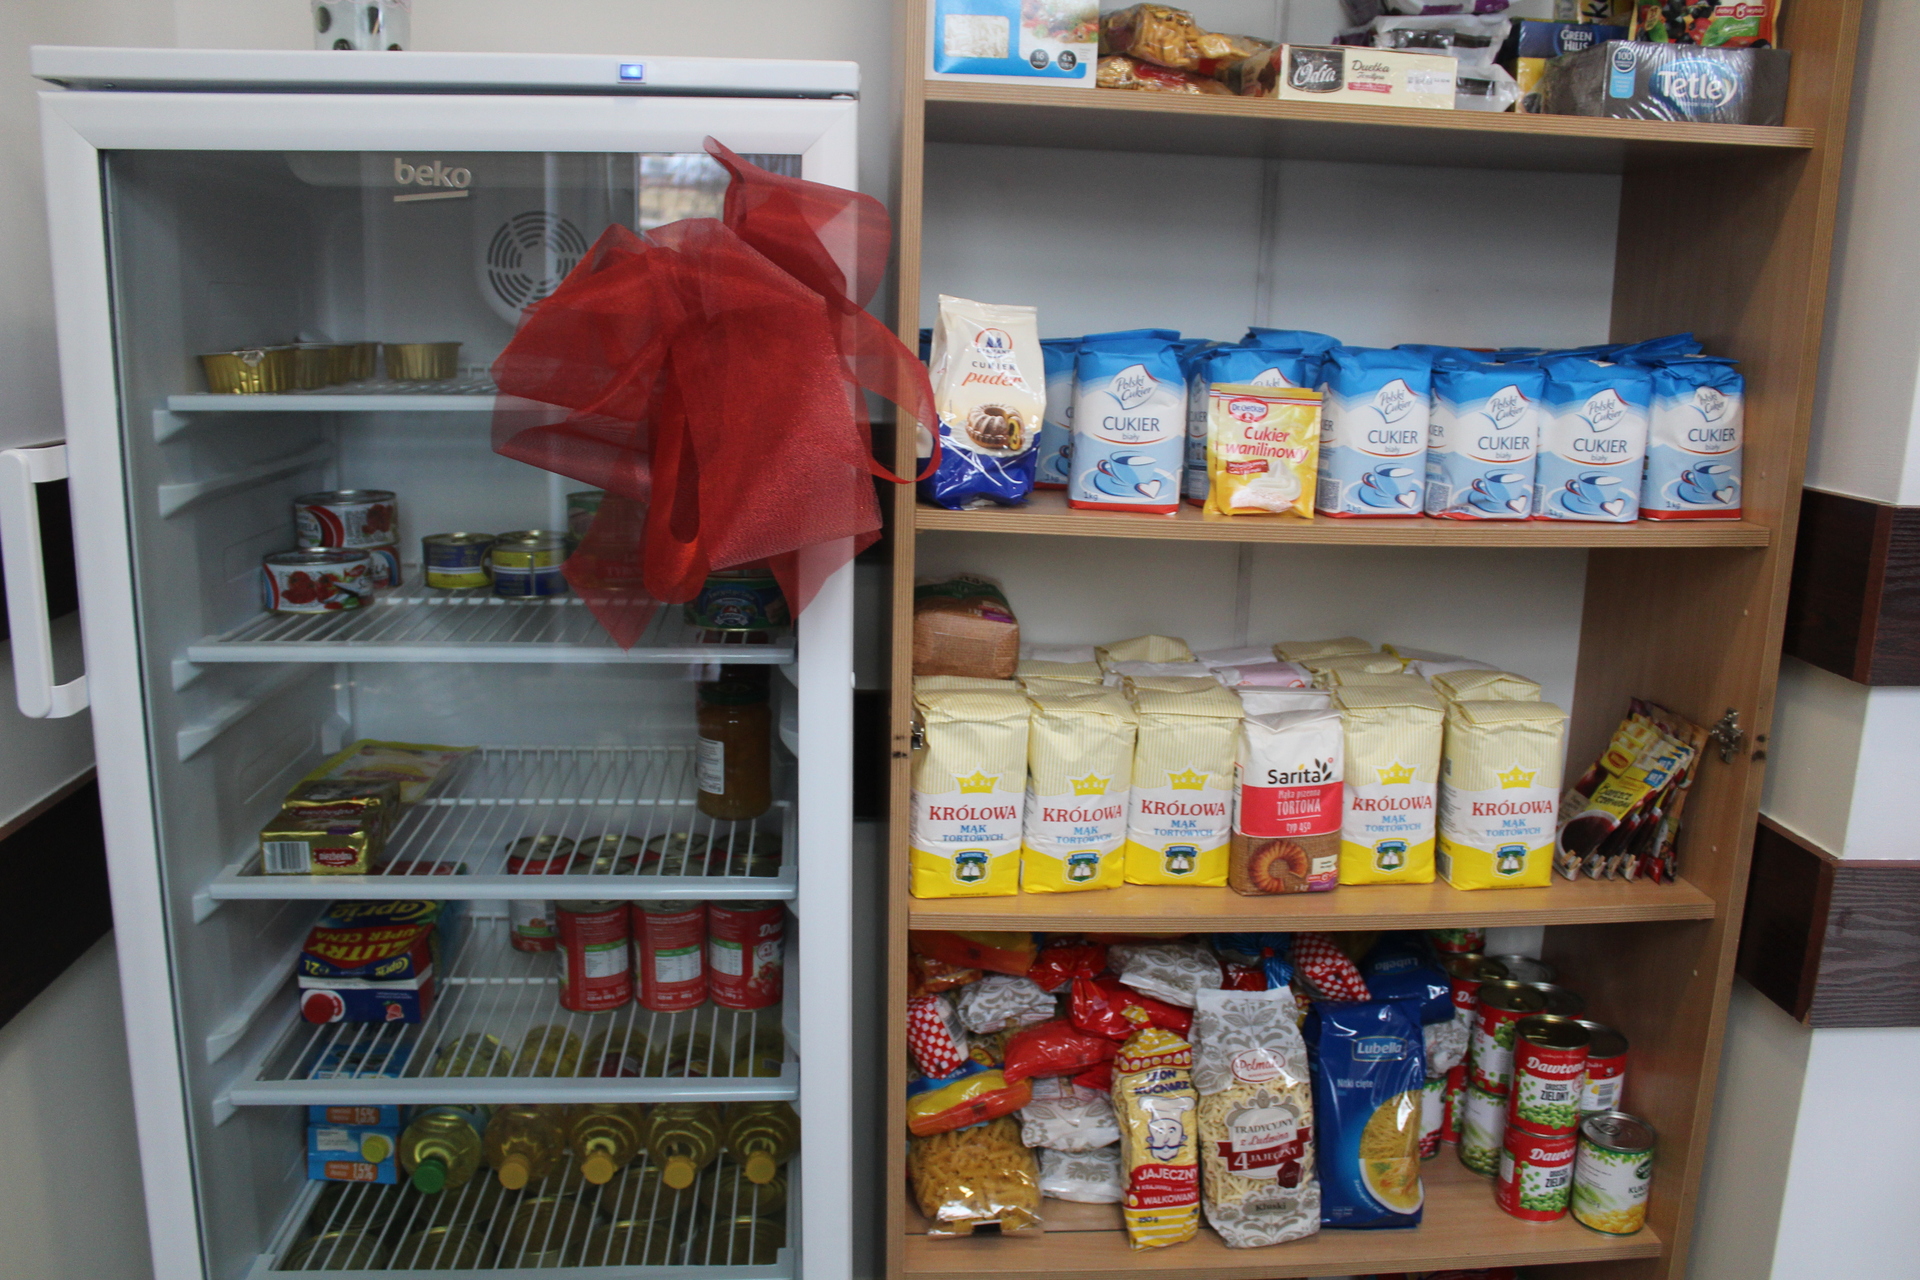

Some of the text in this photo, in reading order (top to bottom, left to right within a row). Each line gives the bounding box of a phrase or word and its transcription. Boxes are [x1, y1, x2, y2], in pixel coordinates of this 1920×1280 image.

[1560, 29, 1593, 41] GREEN
[1563, 40, 1589, 51] HILLS
[1617, 51, 1633, 61] 100
[1293, 61, 1336, 86] Odra
[1351, 59, 1390, 73] Duetka
[1657, 70, 1738, 108] Tetley
[394, 157, 472, 188] beko
[1115, 374, 1145, 393] Polski
[1121, 386, 1153, 402] Cukier
[1379, 388, 1405, 406] Polski
[1385, 399, 1412, 415] Cukier
[1490, 395, 1518, 413] Polski
[1587, 398, 1616, 415] Polski
[1704, 400, 1725, 414] Cukier
[1495, 406, 1524, 421] Cukier
[1593, 408, 1623, 424] Cukier
[1102, 415, 1160, 432] CUKIER
[1122, 432, 1140, 443] biały
[1243, 426, 1290, 442] Cukier
[1367, 429, 1418, 445] CUKIER
[1687, 427, 1736, 442] CUKIER
[1384, 445, 1401, 455] biały
[1477, 435, 1530, 451] CUKIER
[1572, 437, 1628, 454] CUKIER
[1225, 441, 1309, 464] wanilinowy
[1495, 451, 1512, 461] biały
[1590, 454, 1608, 464] biały
[1267, 764, 1322, 785] Sarita
[1277, 789, 1295, 800] Mąka
[1141, 799, 1226, 816] KRÓLOWA
[1276, 799, 1322, 816] TORTOWA
[1352, 795, 1433, 811] KRÓLOWA
[1471, 799, 1553, 816] KRÓLOWA
[929, 805, 1017, 821] KRÓLOWA
[1042, 804, 1123, 823] KRÓLOWA
[1381, 814, 1407, 825] MĄK
[960, 824, 987, 835] MĄK
[1171, 819, 1197, 830] MĄK
[1285, 821, 1311, 834] typ 450
[1365, 822, 1421, 833] TORTOWYCH
[1501, 818, 1526, 829] MĄK
[942, 833, 1004, 842] TORTOWYCH
[1056, 832, 1112, 844] TORTOWYCH
[1073, 826, 1098, 837] MĄK
[1153, 828, 1213, 837] TORTOWYCH
[1485, 826, 1541, 837] TORTOWYCH
[315, 931, 362, 943] CENA
[1374, 956, 1419, 974] Lubella
[1356, 1041, 1403, 1054] Lubella
[1146, 1069, 1177, 1082] LEON
[1134, 1080, 1190, 1095] KUCHARZ
[1336, 1078, 1374, 1090] Nitki cięte
[1541, 1090, 1570, 1102] ZIELONY
[1234, 1117, 1296, 1134] TRADYCYJNY
[1234, 1153, 1250, 1170] 4
[1138, 1167, 1198, 1181] JAJECZNY
